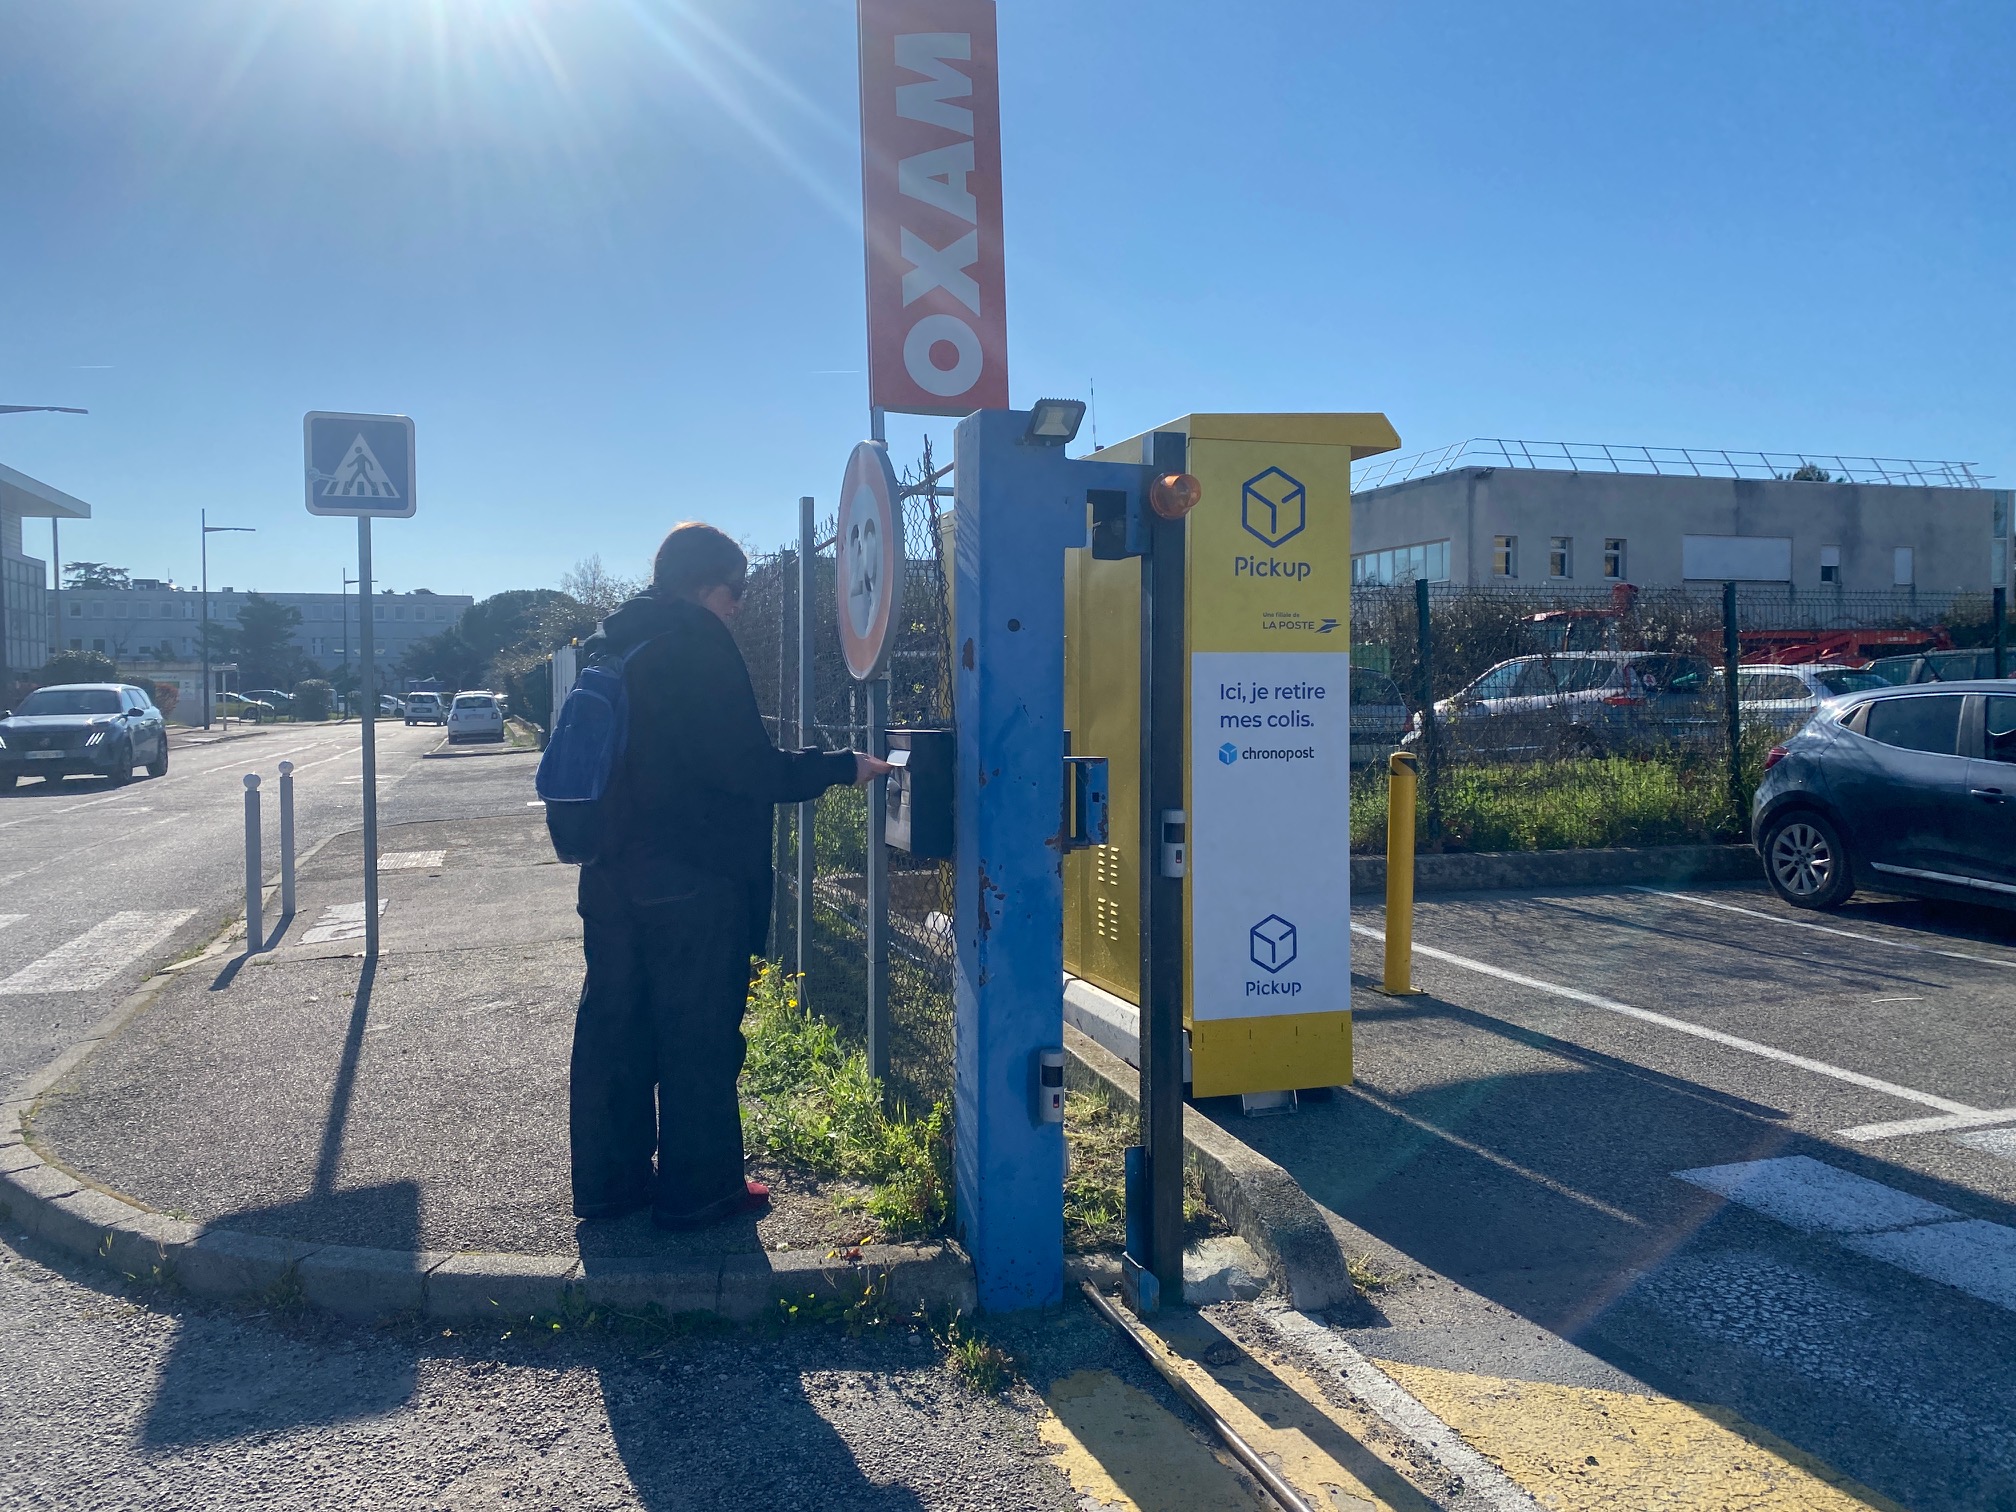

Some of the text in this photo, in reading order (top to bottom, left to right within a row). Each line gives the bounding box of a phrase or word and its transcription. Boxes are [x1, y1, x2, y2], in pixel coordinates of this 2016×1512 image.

[894, 32, 983, 397] OXAM
[1234, 555, 1312, 582] Pickup
[1262, 620, 1316, 630] LA POSTE
[1220, 681, 1326, 704] Ici, je retire
[1220, 709, 1315, 728] mes colis.
[1241, 746, 1315, 762] chronopost
[1245, 979, 1302, 997] Pickup
